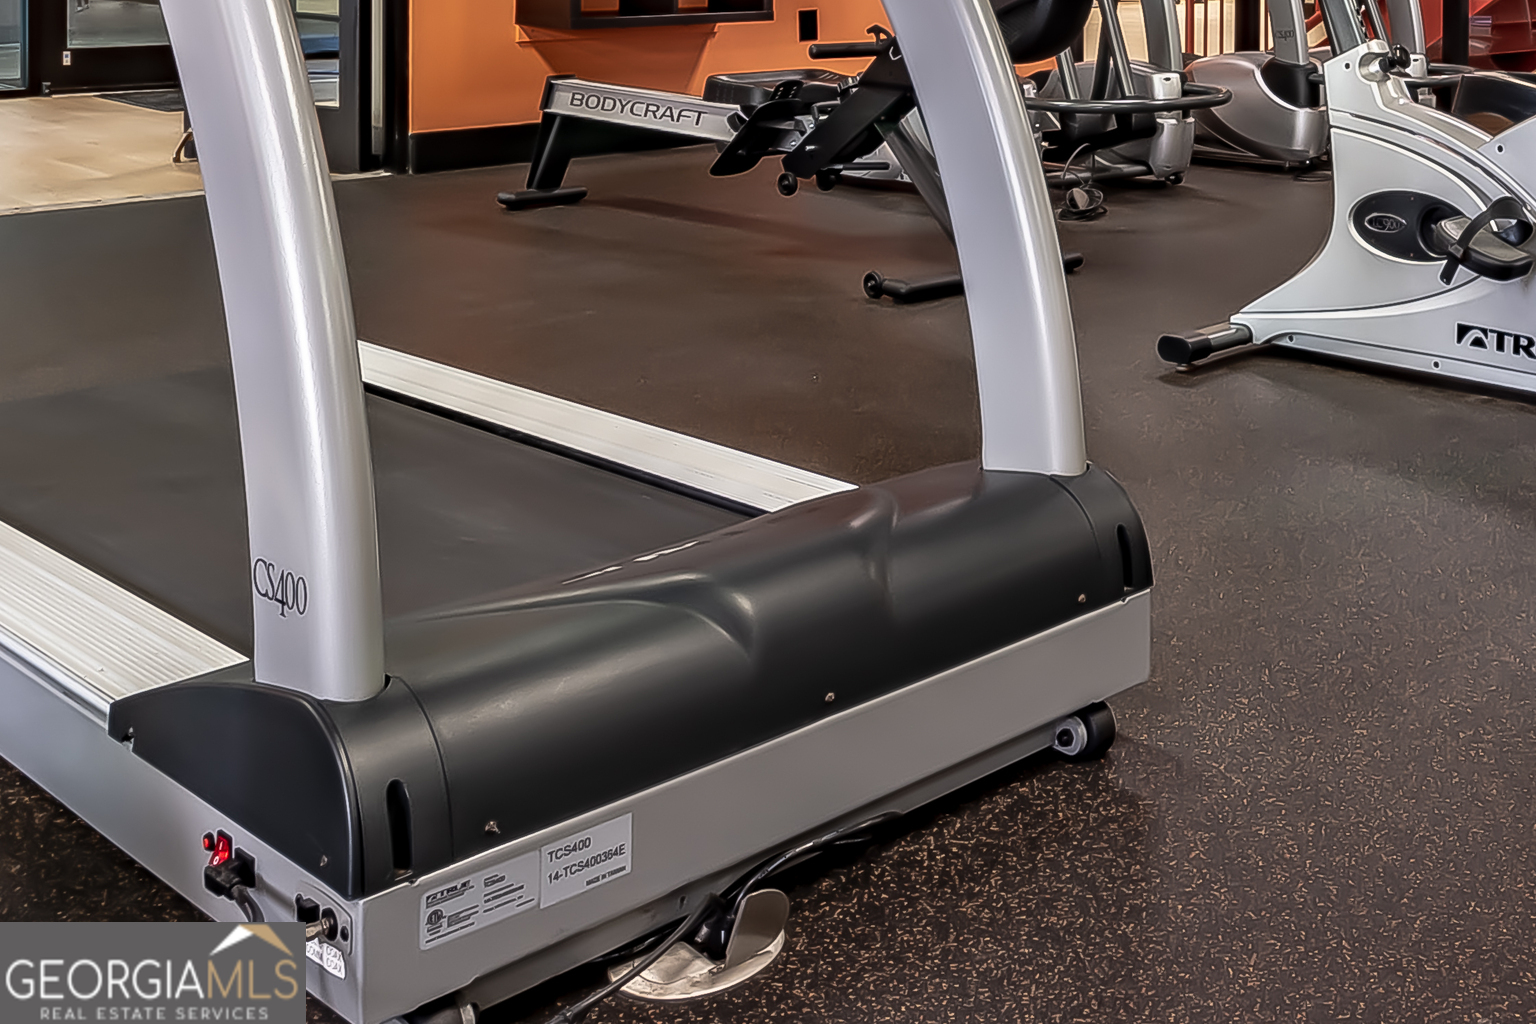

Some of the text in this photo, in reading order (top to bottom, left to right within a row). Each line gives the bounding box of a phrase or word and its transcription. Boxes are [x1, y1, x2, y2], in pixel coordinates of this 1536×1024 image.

[569, 91, 709, 126] BODYCRAFT
[253, 558, 308, 618] CS400
[547, 837, 592, 863] TCS400
[547, 843, 627, 885] 14-TCS400364E
